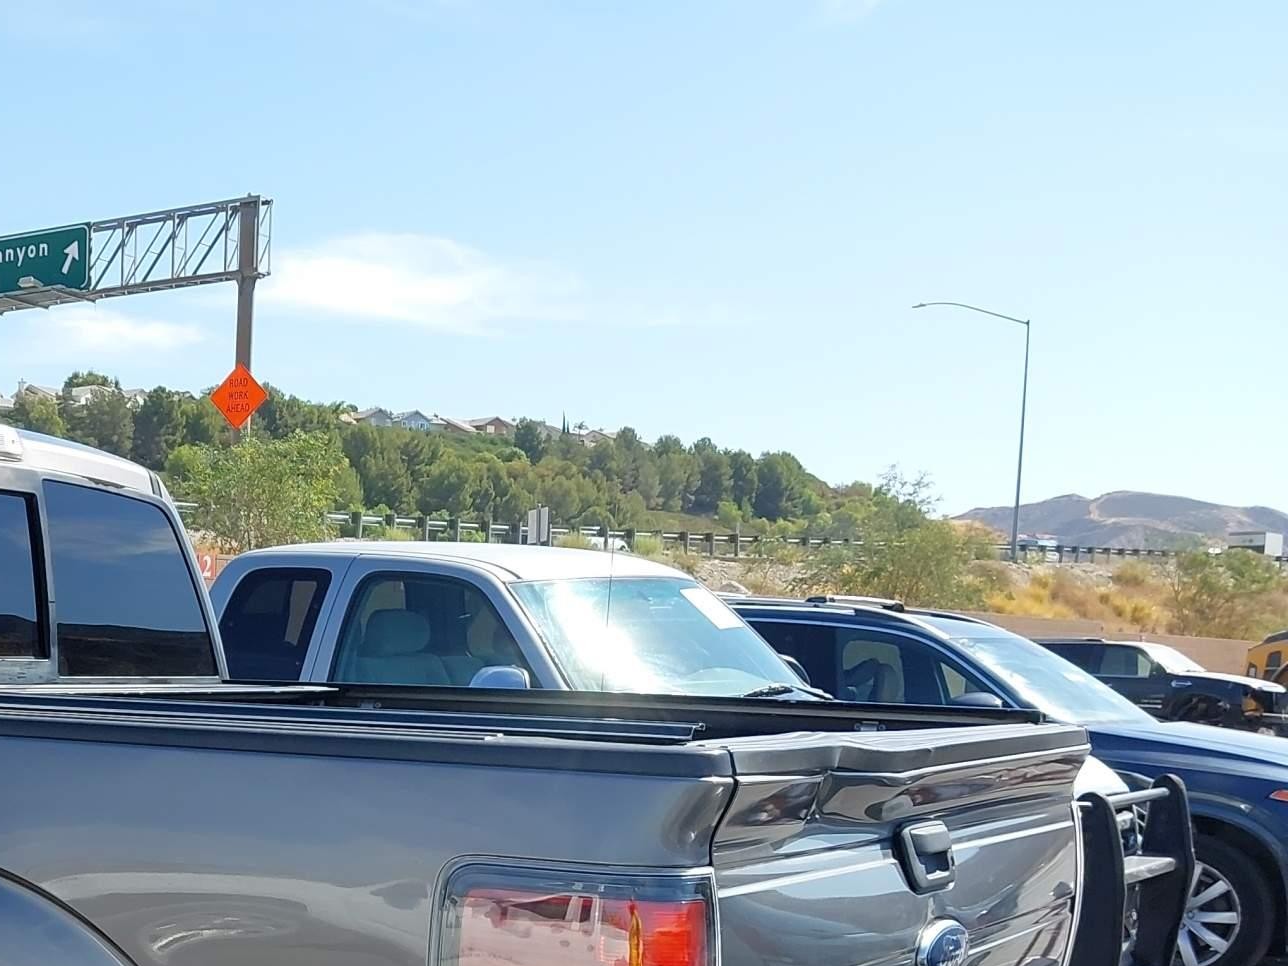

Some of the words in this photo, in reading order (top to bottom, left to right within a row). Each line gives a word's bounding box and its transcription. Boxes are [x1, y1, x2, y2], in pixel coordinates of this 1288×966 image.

[229, 377, 249, 388] ROAD
[228, 390, 249, 400] WORK
[226, 402, 250, 413] AHEAD
